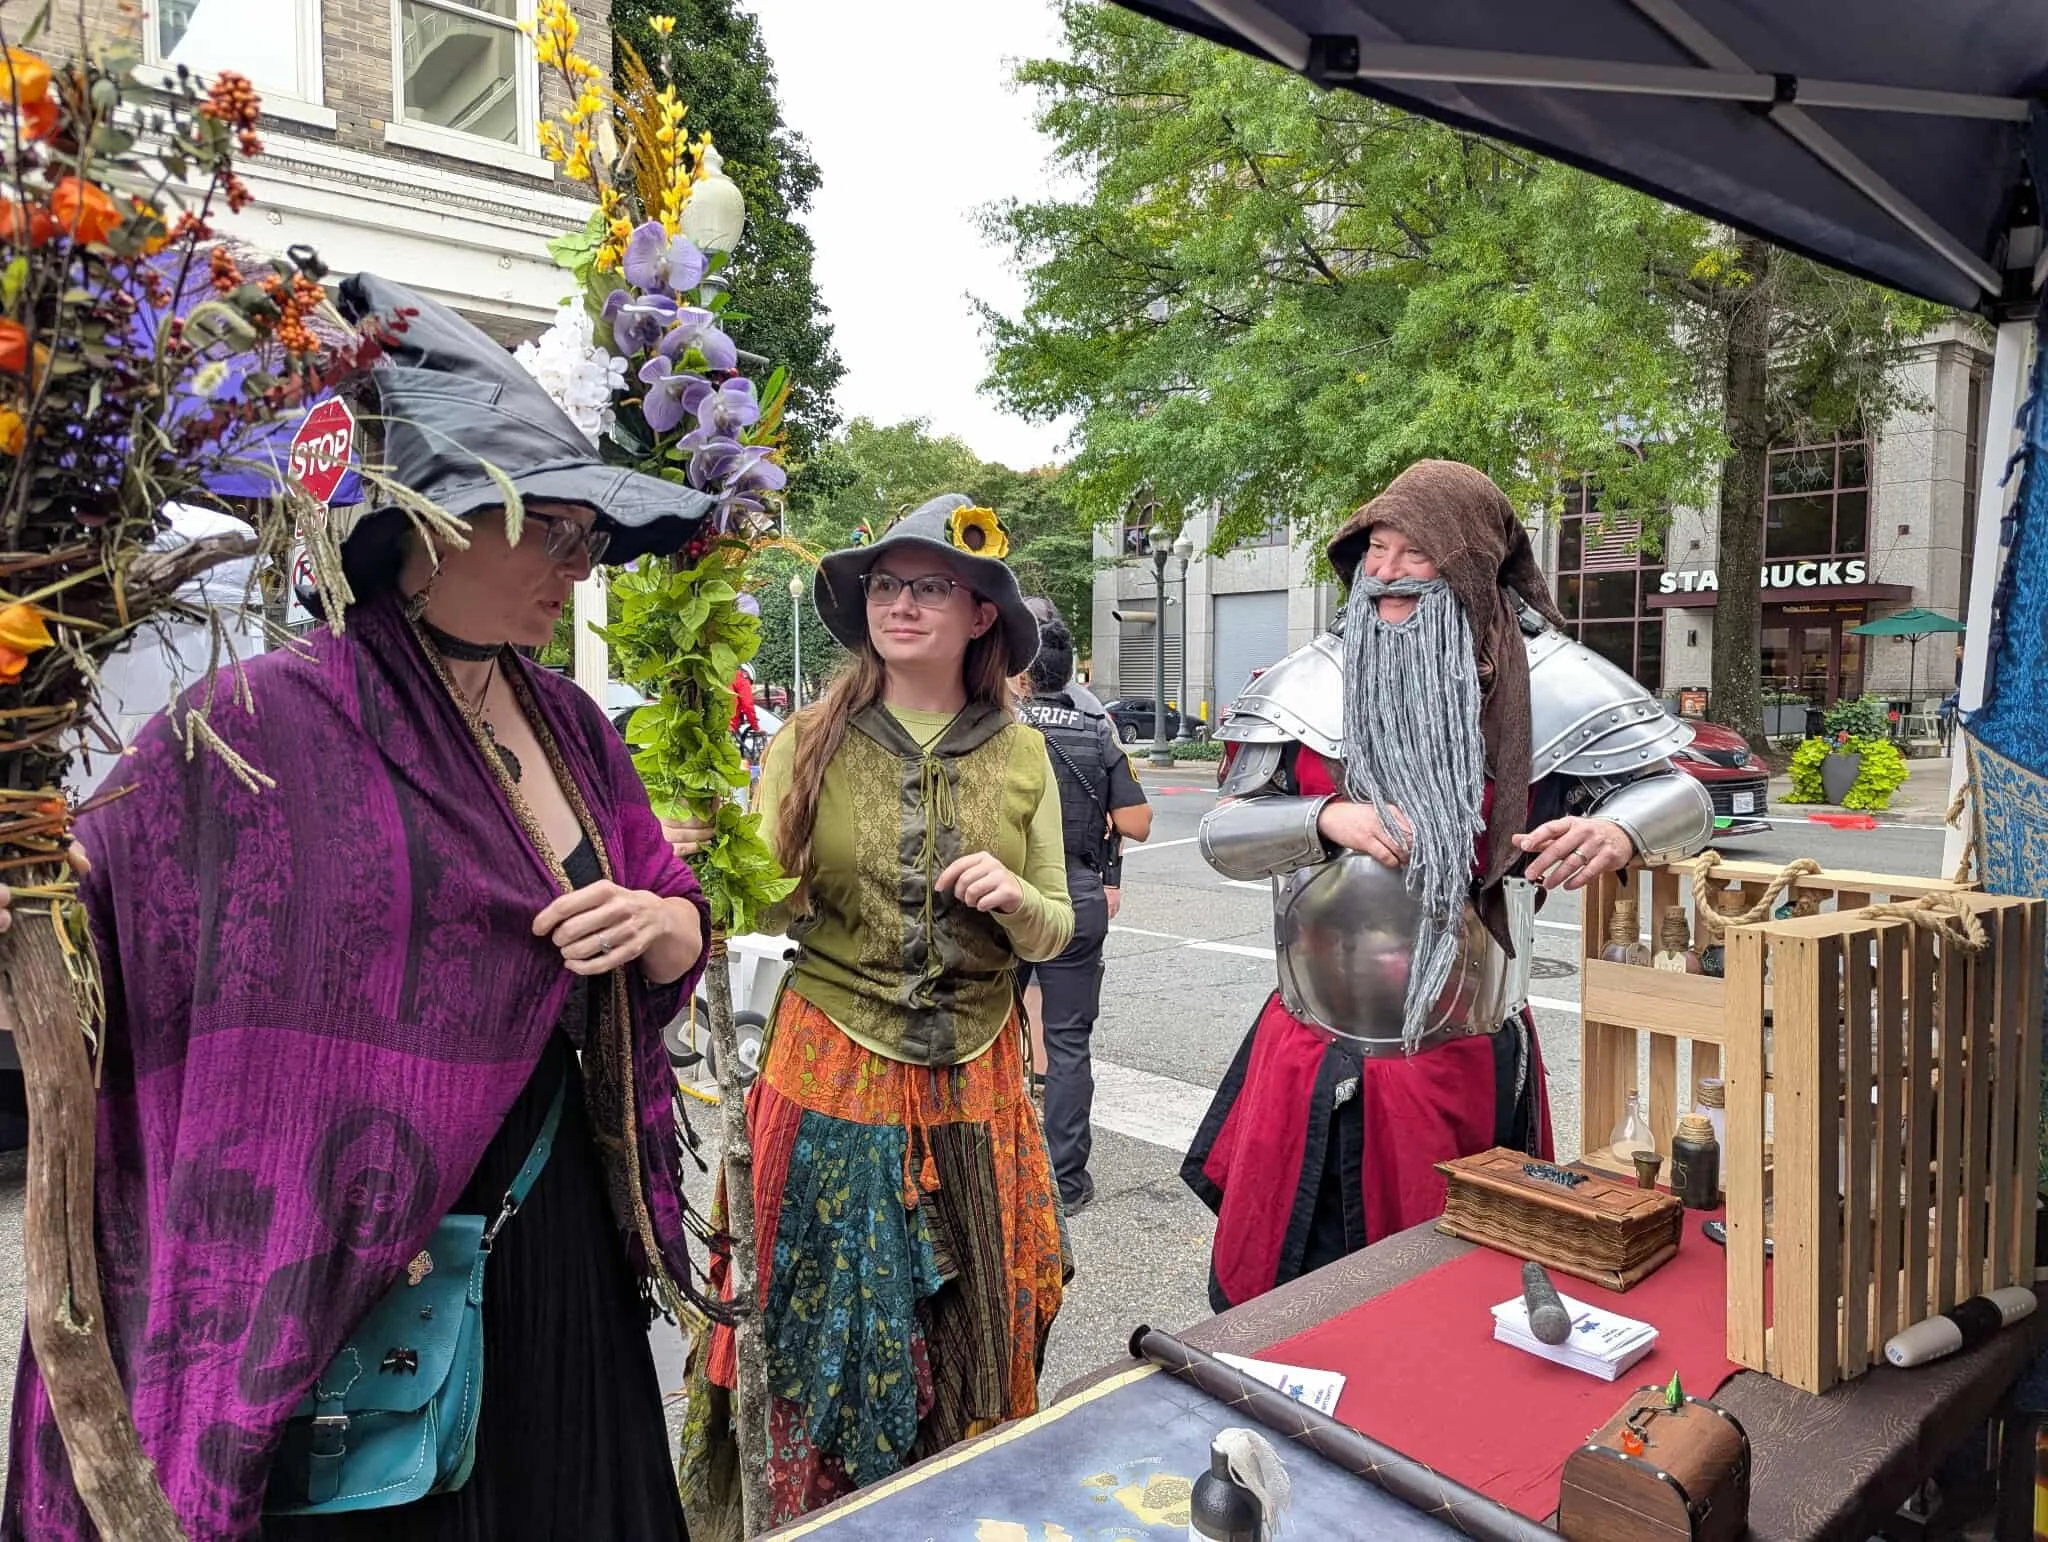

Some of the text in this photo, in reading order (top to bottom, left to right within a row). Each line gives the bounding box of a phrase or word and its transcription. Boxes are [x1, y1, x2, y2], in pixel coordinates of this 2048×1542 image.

[292, 428, 348, 480] STOP
[1659, 560, 1866, 594] STAUCKS
[1016, 706, 1080, 725] HERIFF
